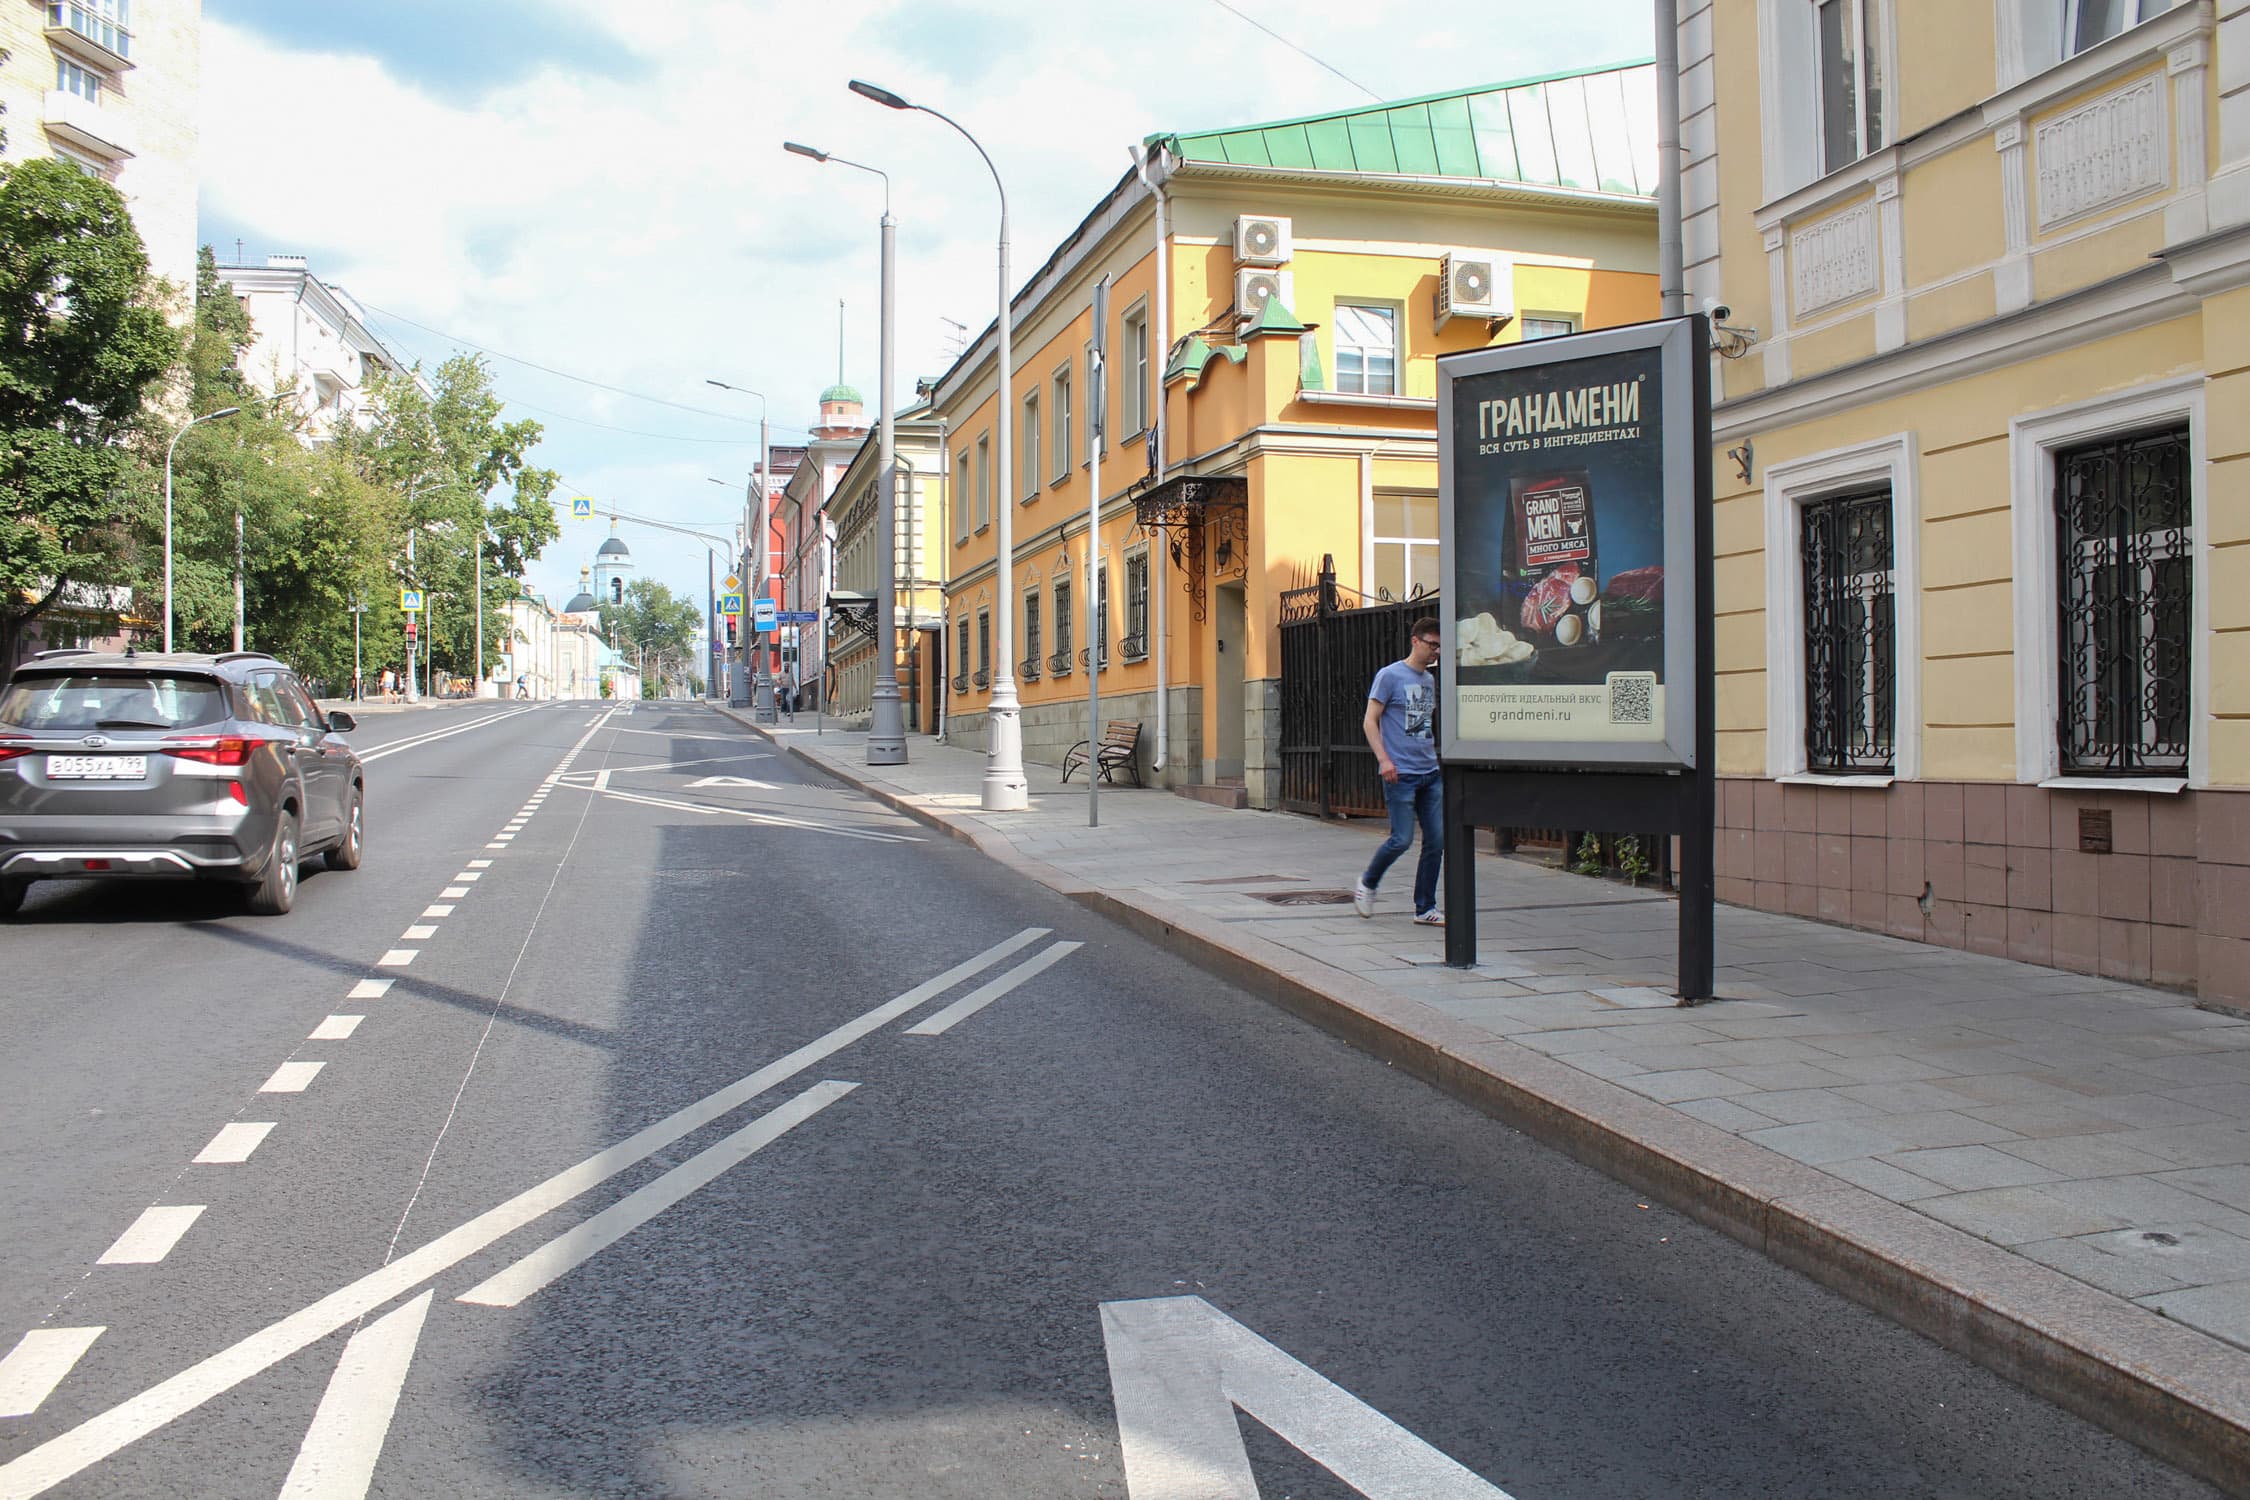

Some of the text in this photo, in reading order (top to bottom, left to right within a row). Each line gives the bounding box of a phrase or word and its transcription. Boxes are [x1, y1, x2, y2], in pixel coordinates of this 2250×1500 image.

[1479, 381, 1640, 440] ГРАНДМЕНИ
[1479, 426, 1640, 455] ВСЯ СУТЬ В ИНГРЕДИЕНТАХ!
[1525, 498, 1560, 516] GRAND
[1527, 514, 1562, 541] MENI
[1529, 540, 1585, 554] МНОГО МЯСА
[1461, 693, 1602, 704] ПОПРОБУЙТЕ ИДЕАЛЬНЫЙ ВКУС
[1489, 708, 1571, 723] grandmeni.ru
